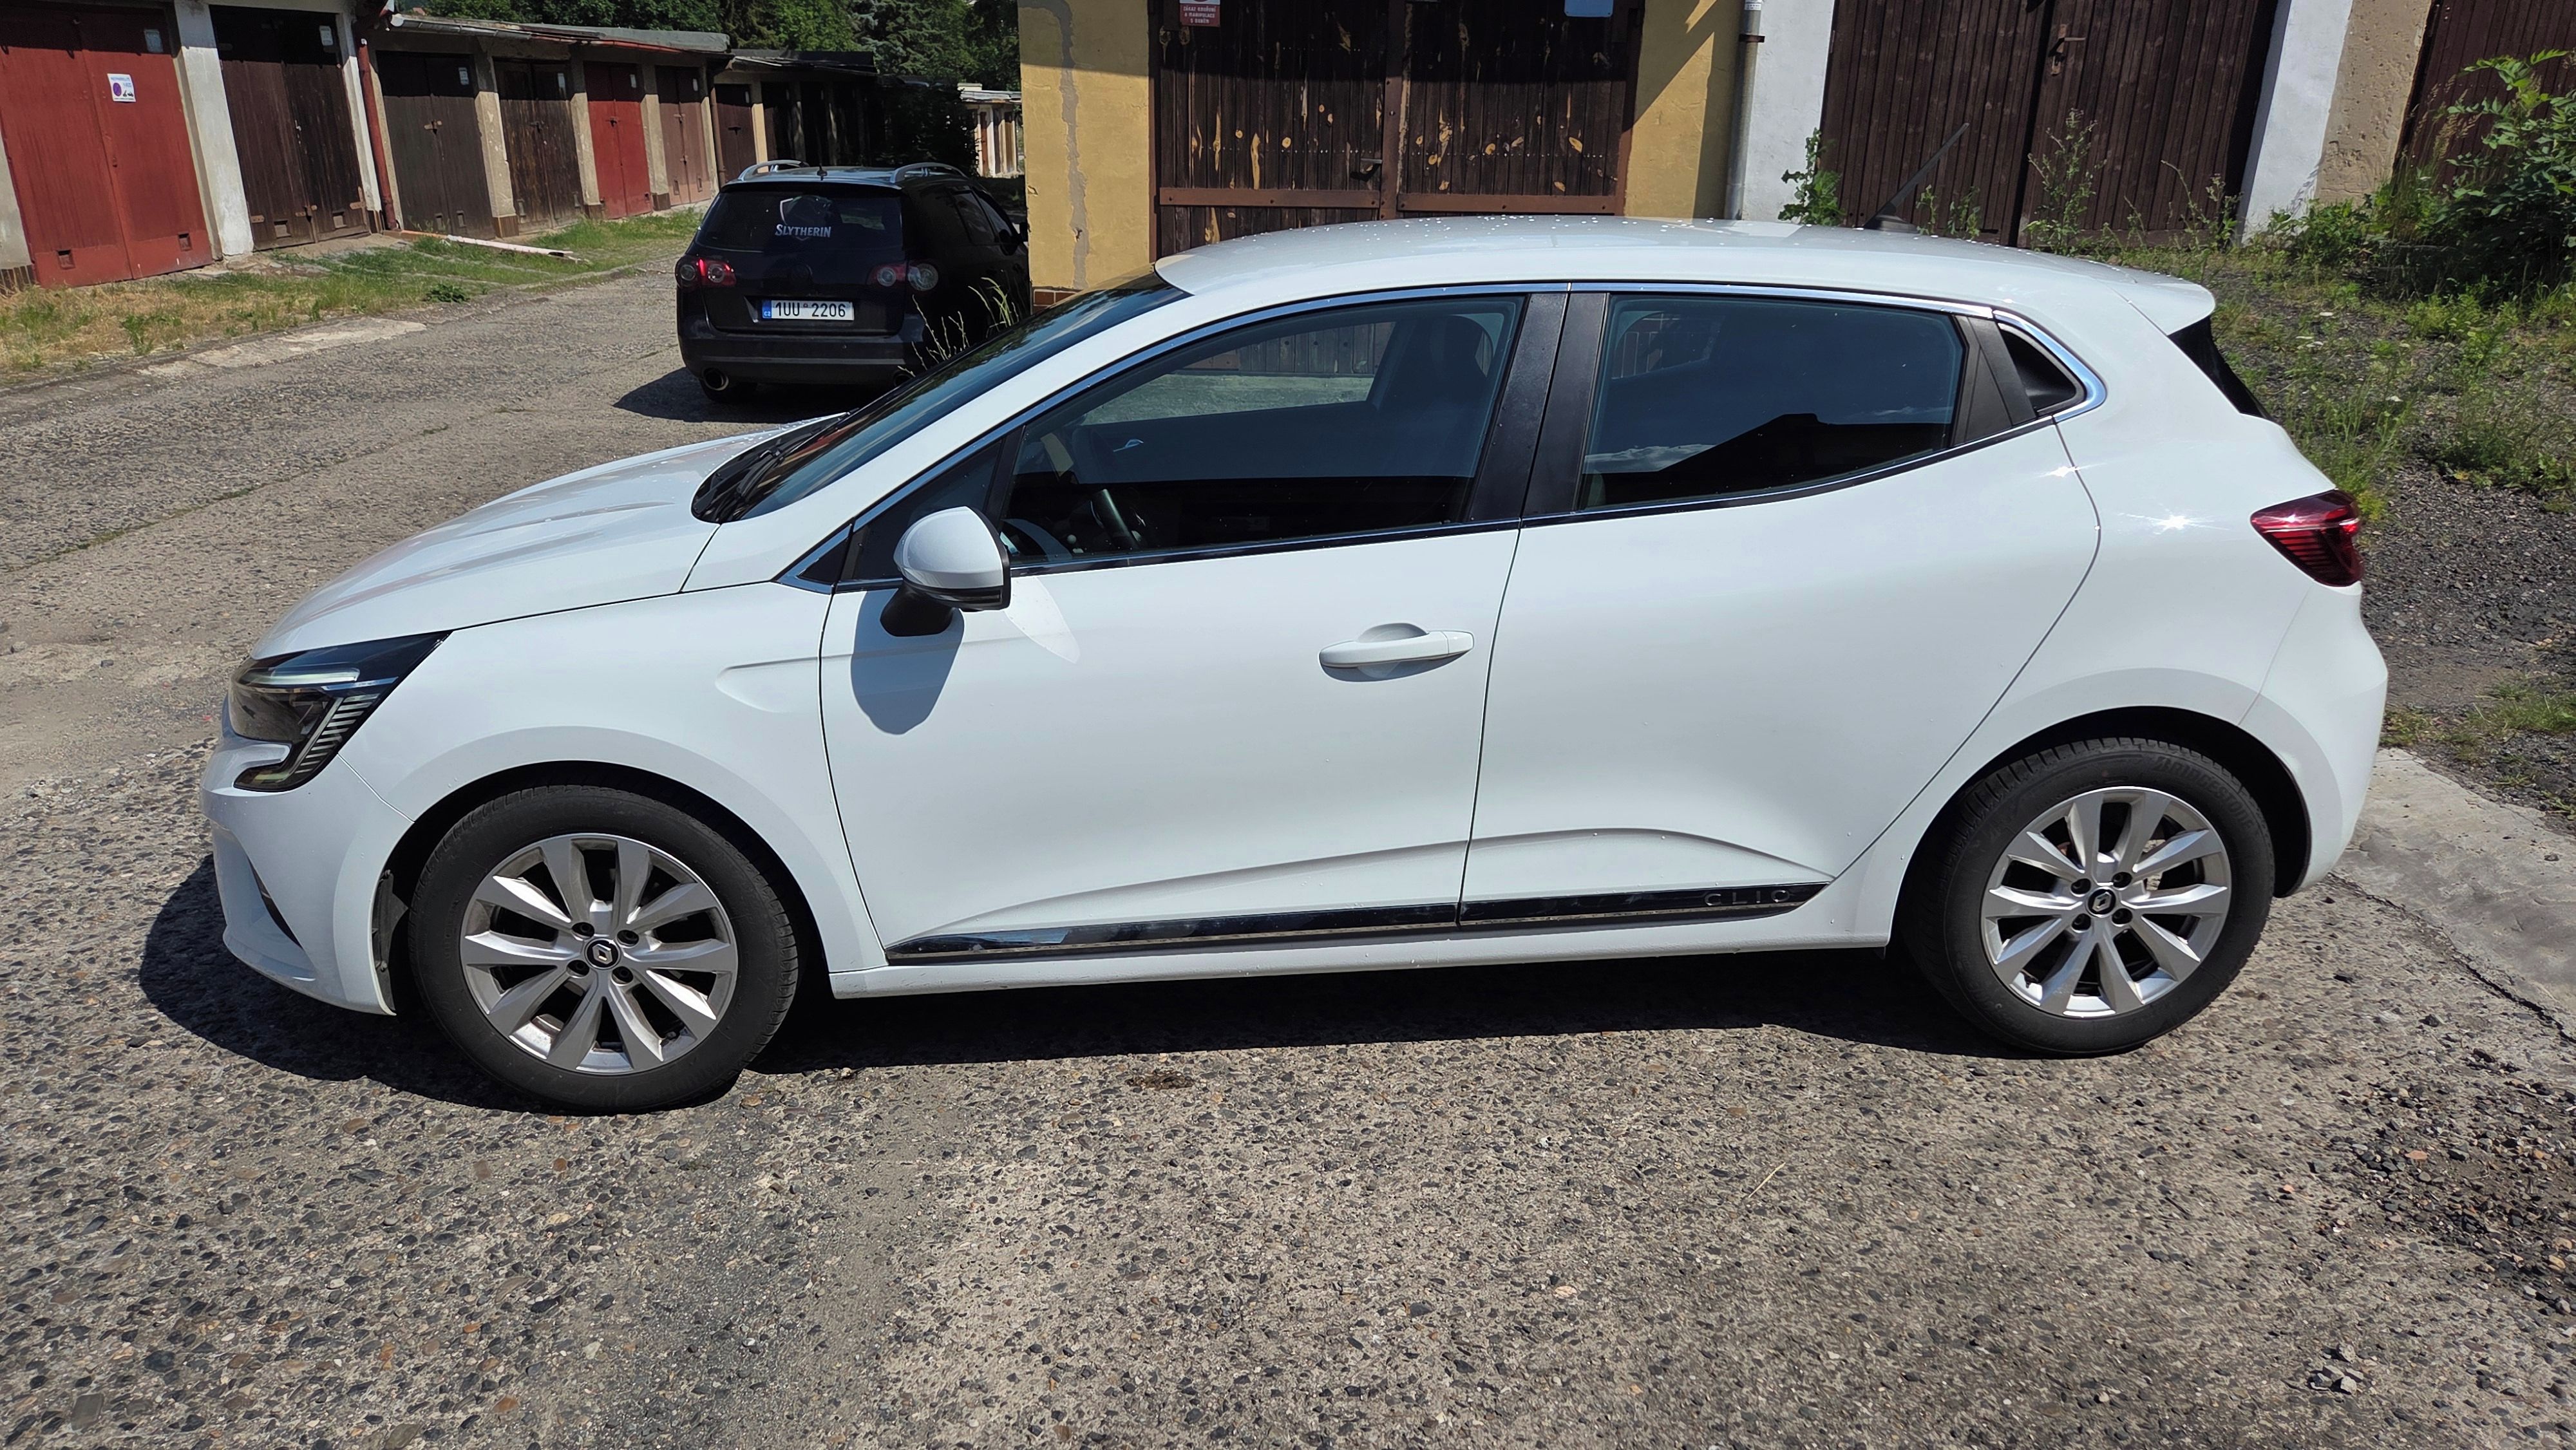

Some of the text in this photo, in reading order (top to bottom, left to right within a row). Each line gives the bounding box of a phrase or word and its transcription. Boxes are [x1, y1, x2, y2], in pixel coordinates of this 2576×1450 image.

[775, 223, 831, 238] SLYTHERIN
[775, 302, 846, 317] 1UU 2206
[1705, 890, 1790, 906] CLIO
